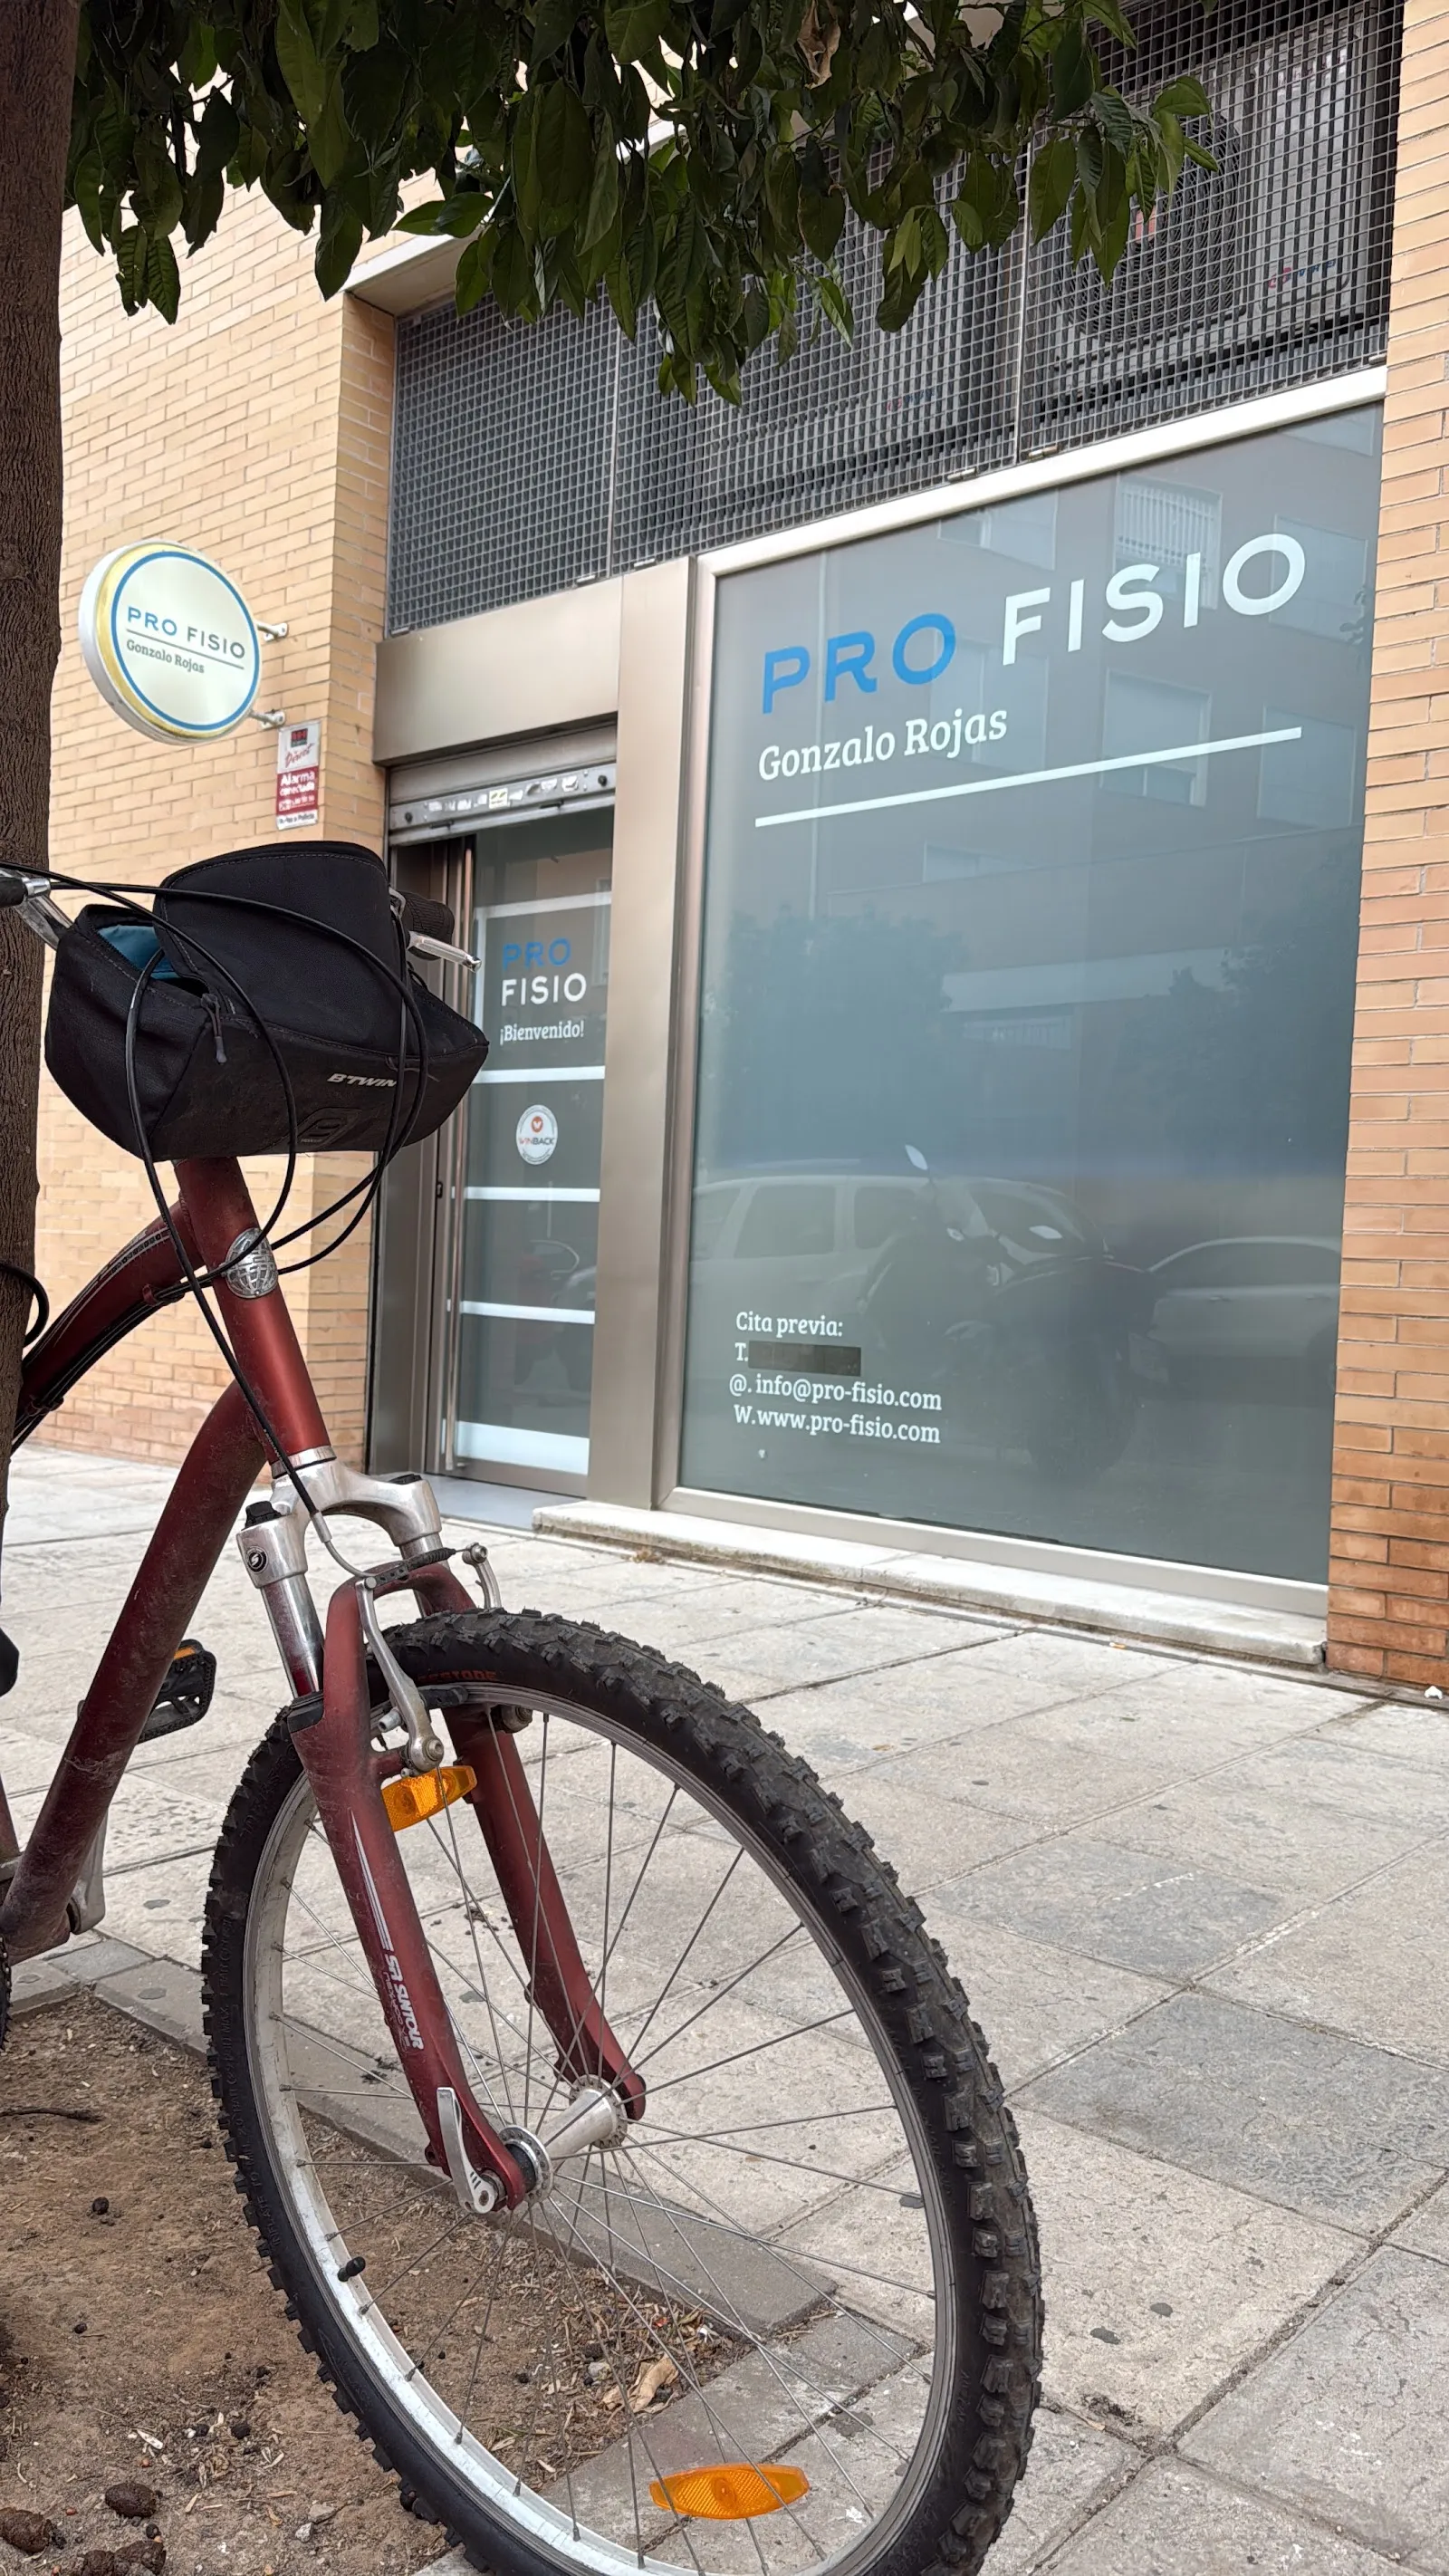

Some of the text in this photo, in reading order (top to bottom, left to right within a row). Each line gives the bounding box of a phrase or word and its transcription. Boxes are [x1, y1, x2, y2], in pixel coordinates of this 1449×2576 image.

[128, 606, 245, 659] PRO FISIO
[762, 533, 1305, 714] PRO FISIO
[126, 639, 205, 673] Gonzalo Rojas
[758, 708, 1008, 781] Gonzalo Rojas
[281, 771, 315, 786] Alarma
[503, 937, 571, 969] PRO
[501, 973, 587, 1006] FISIO
[499, 1019, 585, 1046] ¡Bienvenido!
[736, 1311, 842, 1338] Cita previa:
[755, 1373, 942, 1410] info@pro-fisio.com
[393, 1983, 425, 2050] SUNTOUR
